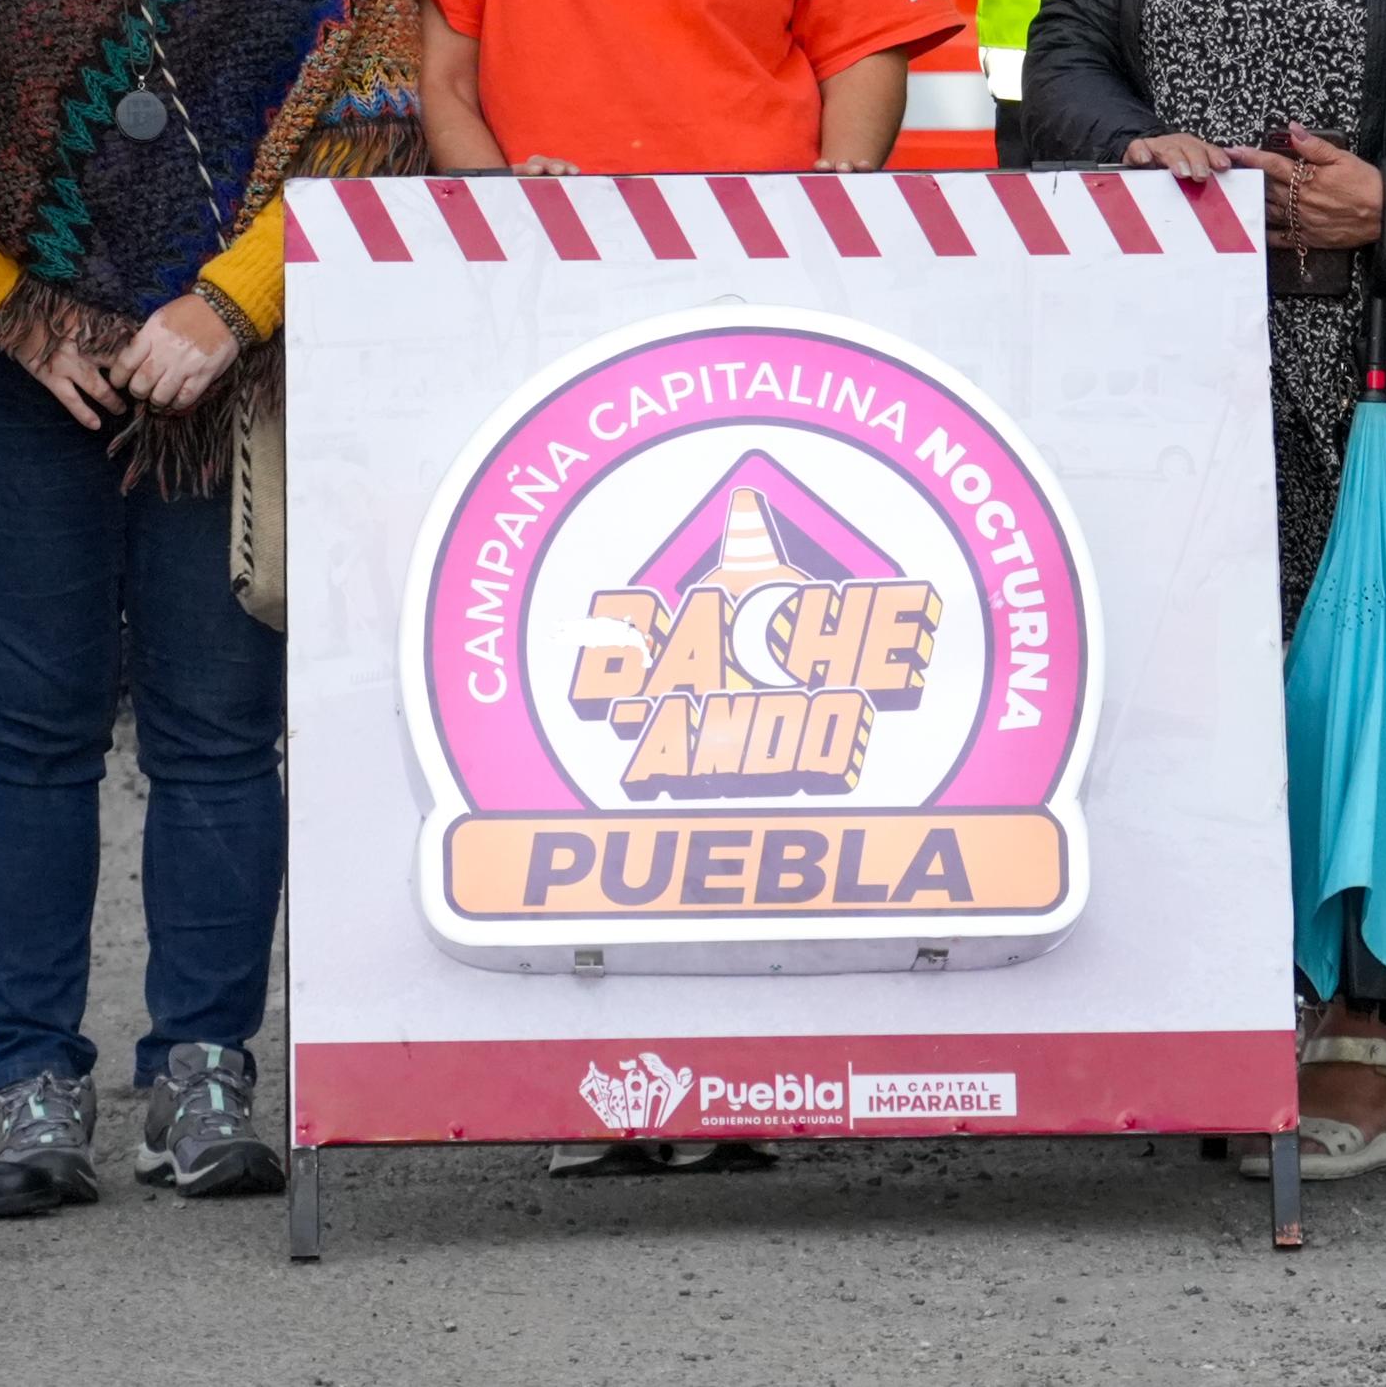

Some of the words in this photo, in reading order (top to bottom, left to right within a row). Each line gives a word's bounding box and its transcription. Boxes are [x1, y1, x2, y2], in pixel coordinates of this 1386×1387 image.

[464, 441, 589, 704] CAMPAÑA
[588, 362, 907, 443] CAPITALINA
[915, 427, 1050, 732] NOCTURNA
[522, 828, 974, 907] PUEBLA
[699, 1074, 843, 1111] Puebla
[876, 1082, 898, 1093] LA
[908, 1081, 990, 1093] CAPITAL
[868, 1094, 1002, 1113] IMPARABLE
[701, 1116, 761, 1126] GOBIERNO
[764, 1115, 780, 1125] DE
[783, 1115, 796, 1125] LA
[799, 1114, 843, 1124] CIUDAD
